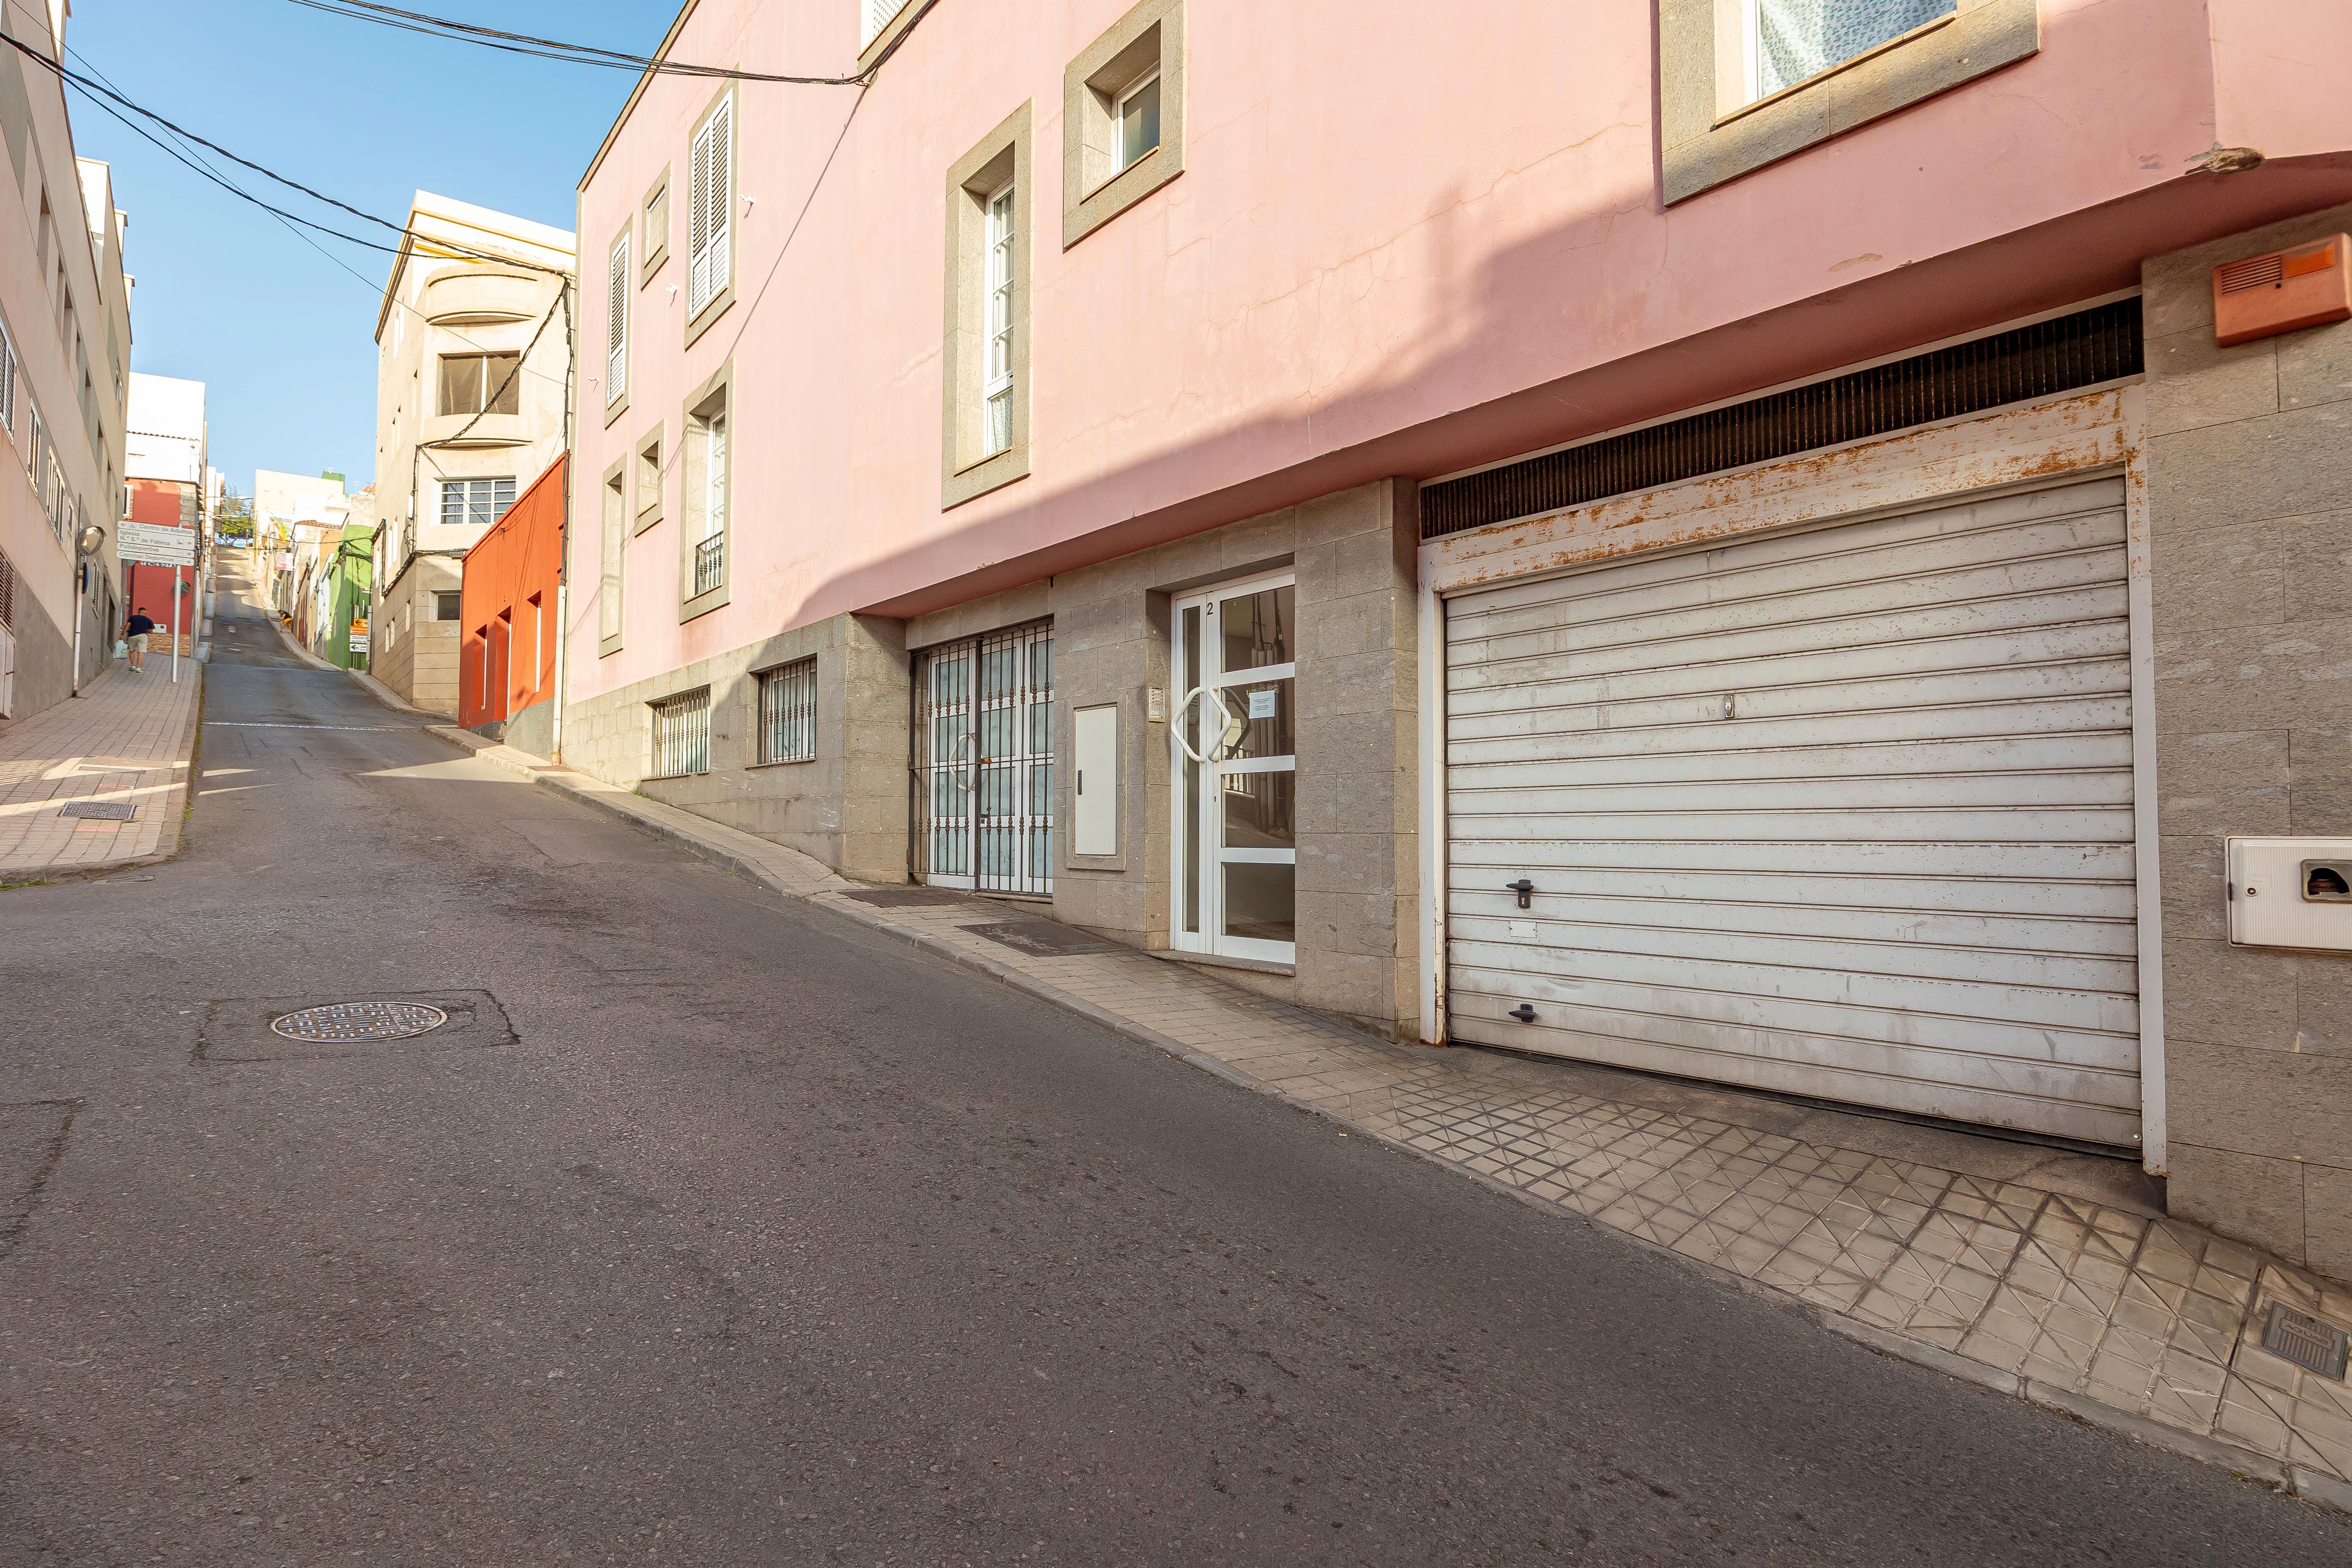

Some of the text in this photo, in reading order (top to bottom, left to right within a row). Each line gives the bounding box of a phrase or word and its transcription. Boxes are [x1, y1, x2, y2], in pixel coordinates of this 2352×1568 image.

[120, 543, 159, 553] Polideportivo
[1207, 602, 1213, 615] 2
[2284, 1324, 2328, 1345] AGUAS
